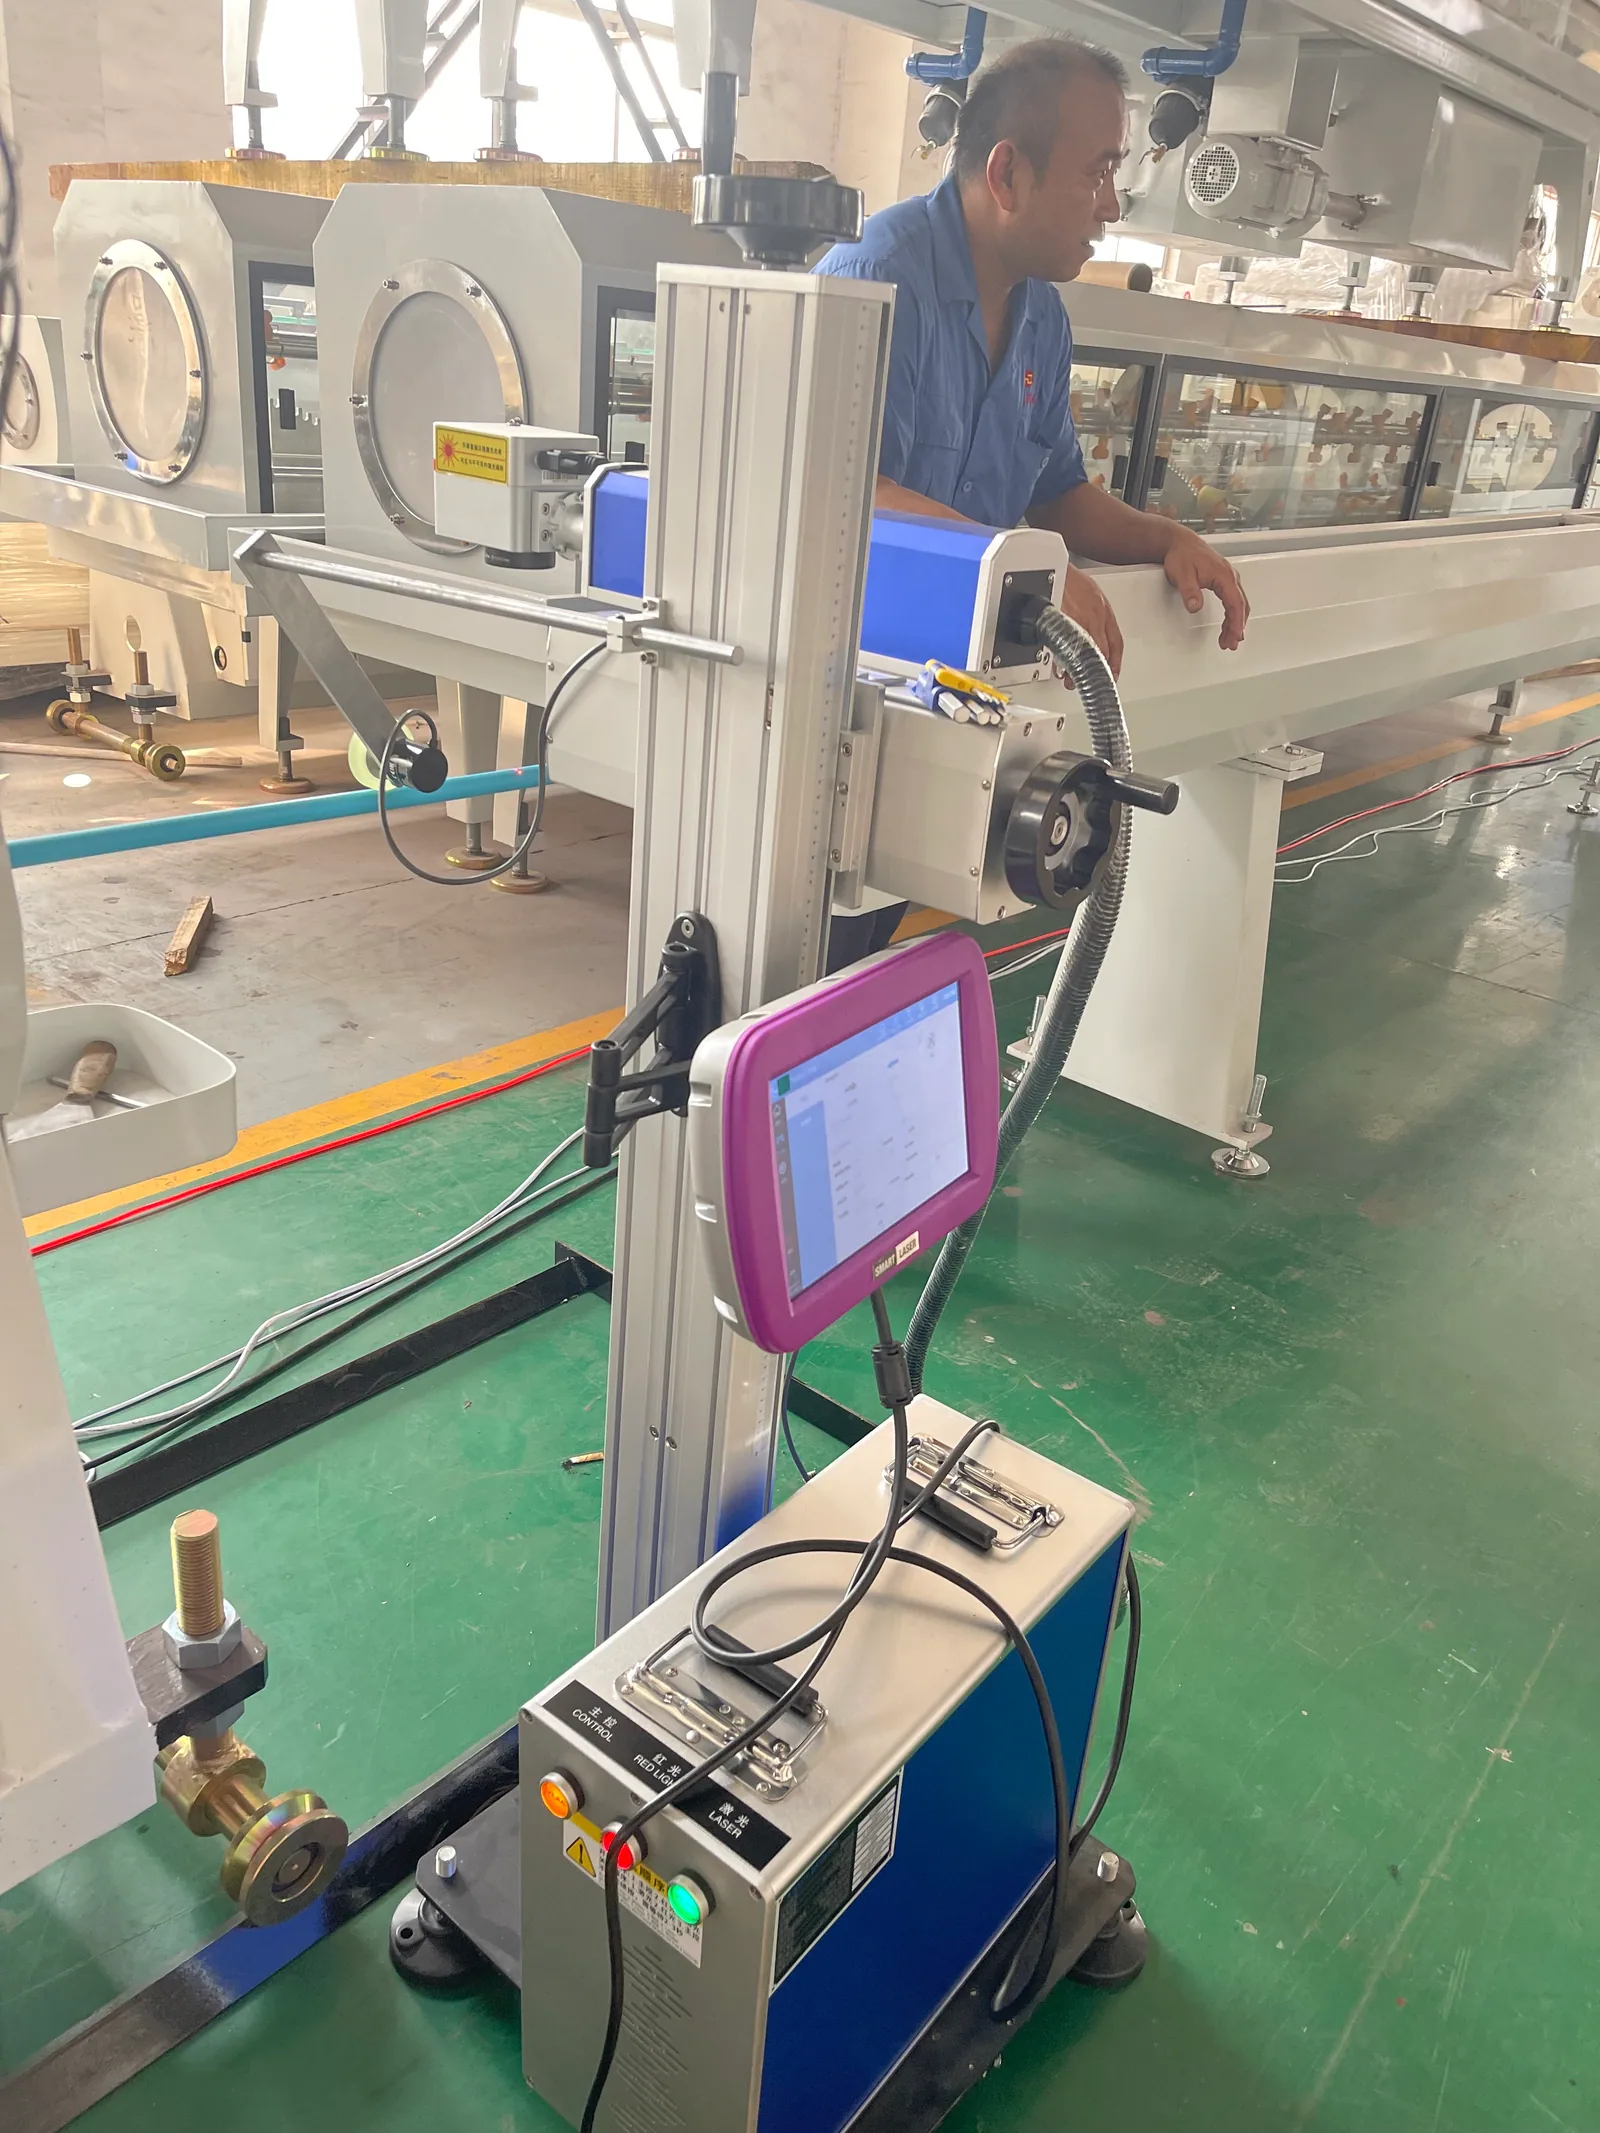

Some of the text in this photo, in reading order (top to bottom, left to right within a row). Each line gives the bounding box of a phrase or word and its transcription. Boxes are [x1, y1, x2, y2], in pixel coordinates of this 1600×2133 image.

[874, 1238, 917, 1277] SMART LASER
[572, 1708, 614, 1743] CONTROL
[633, 1753, 676, 1787] RED LIGH
[708, 1810, 742, 1839] LASER
[718, 1801, 750, 1829] 激光
